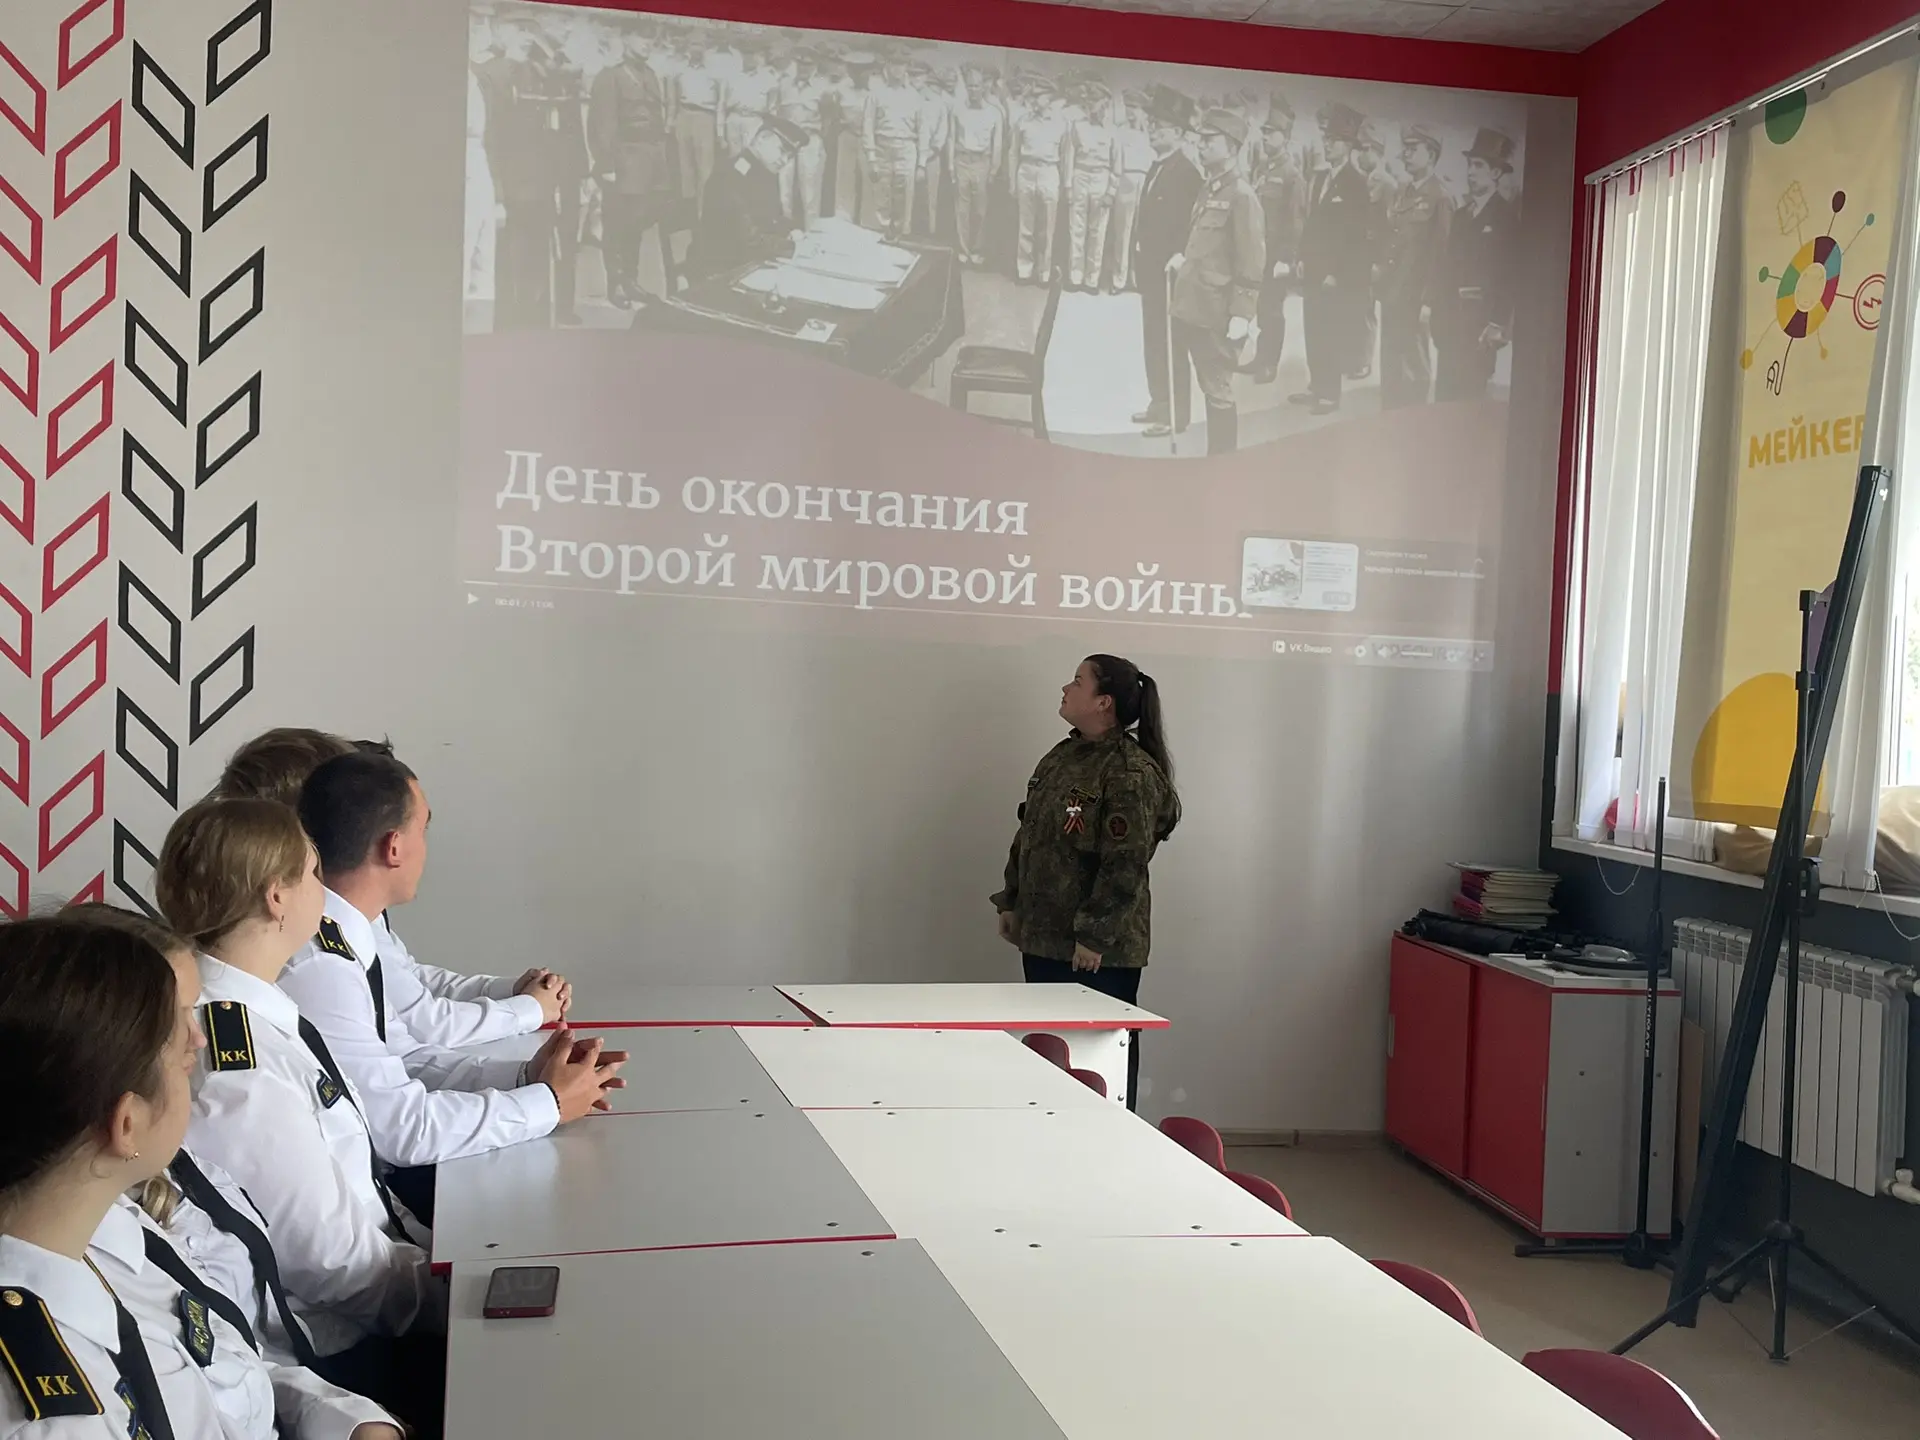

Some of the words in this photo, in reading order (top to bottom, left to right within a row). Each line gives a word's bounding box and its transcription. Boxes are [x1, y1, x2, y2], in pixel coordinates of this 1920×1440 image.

[497, 449, 660, 511] День
[683, 474, 1029, 537] окончания
[496, 525, 735, 594] Второй
[760, 554, 1037, 610] мировой
